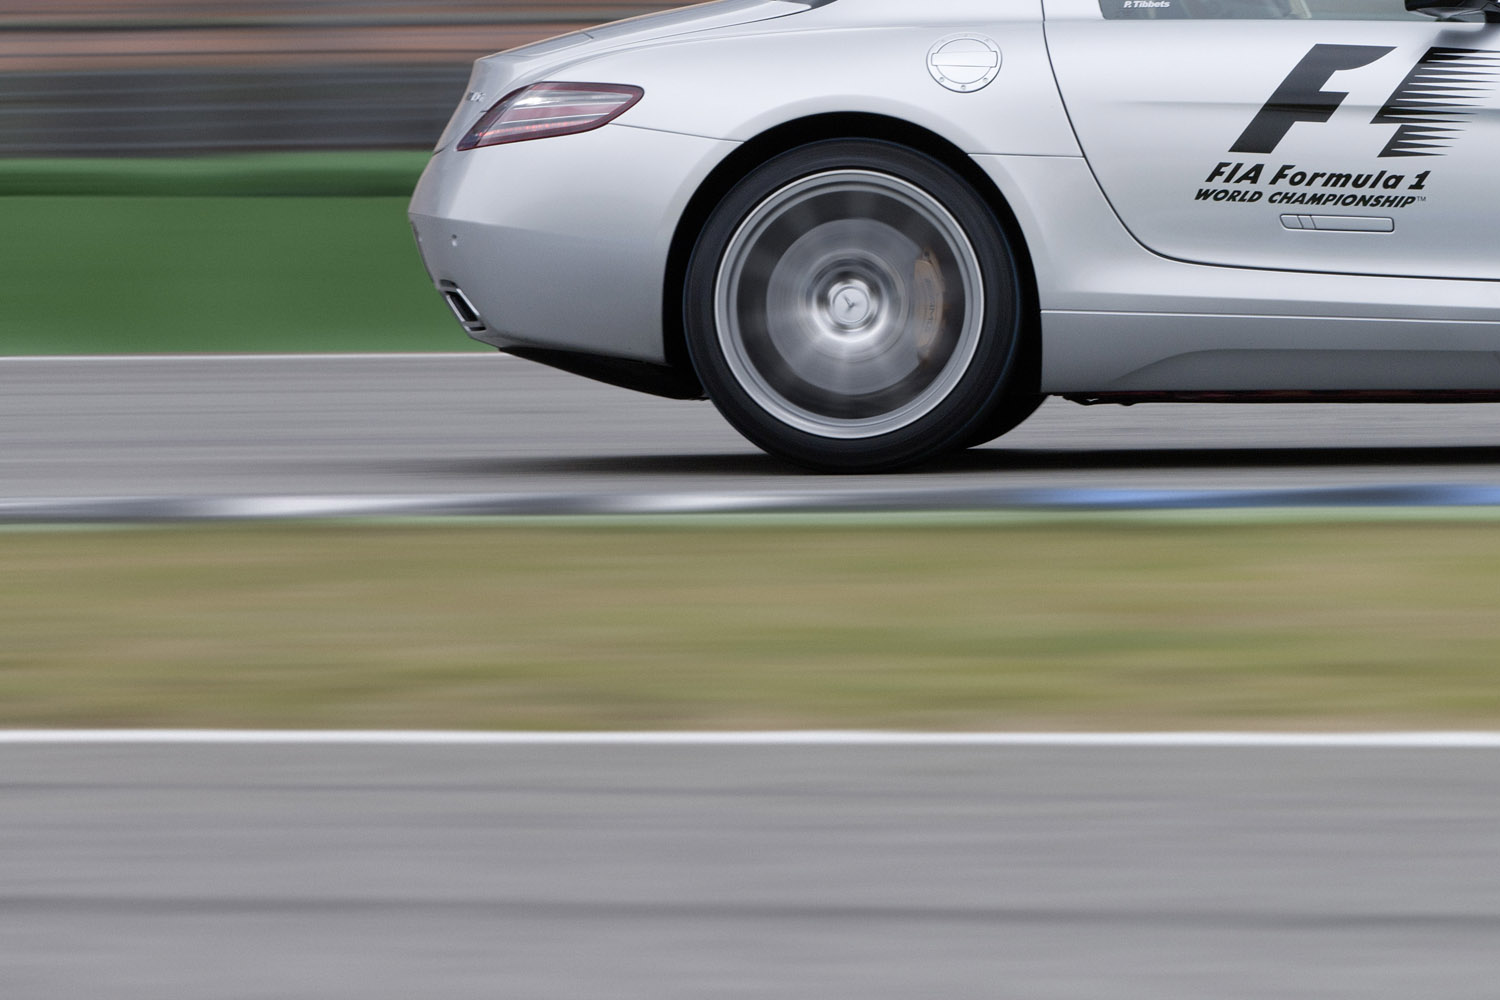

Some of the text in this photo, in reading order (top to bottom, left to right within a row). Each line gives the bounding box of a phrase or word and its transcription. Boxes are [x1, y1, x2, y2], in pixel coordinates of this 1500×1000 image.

[1205, 162, 1431, 190] FIA Formula 1
[1194, 189, 1264, 203] WORLD
